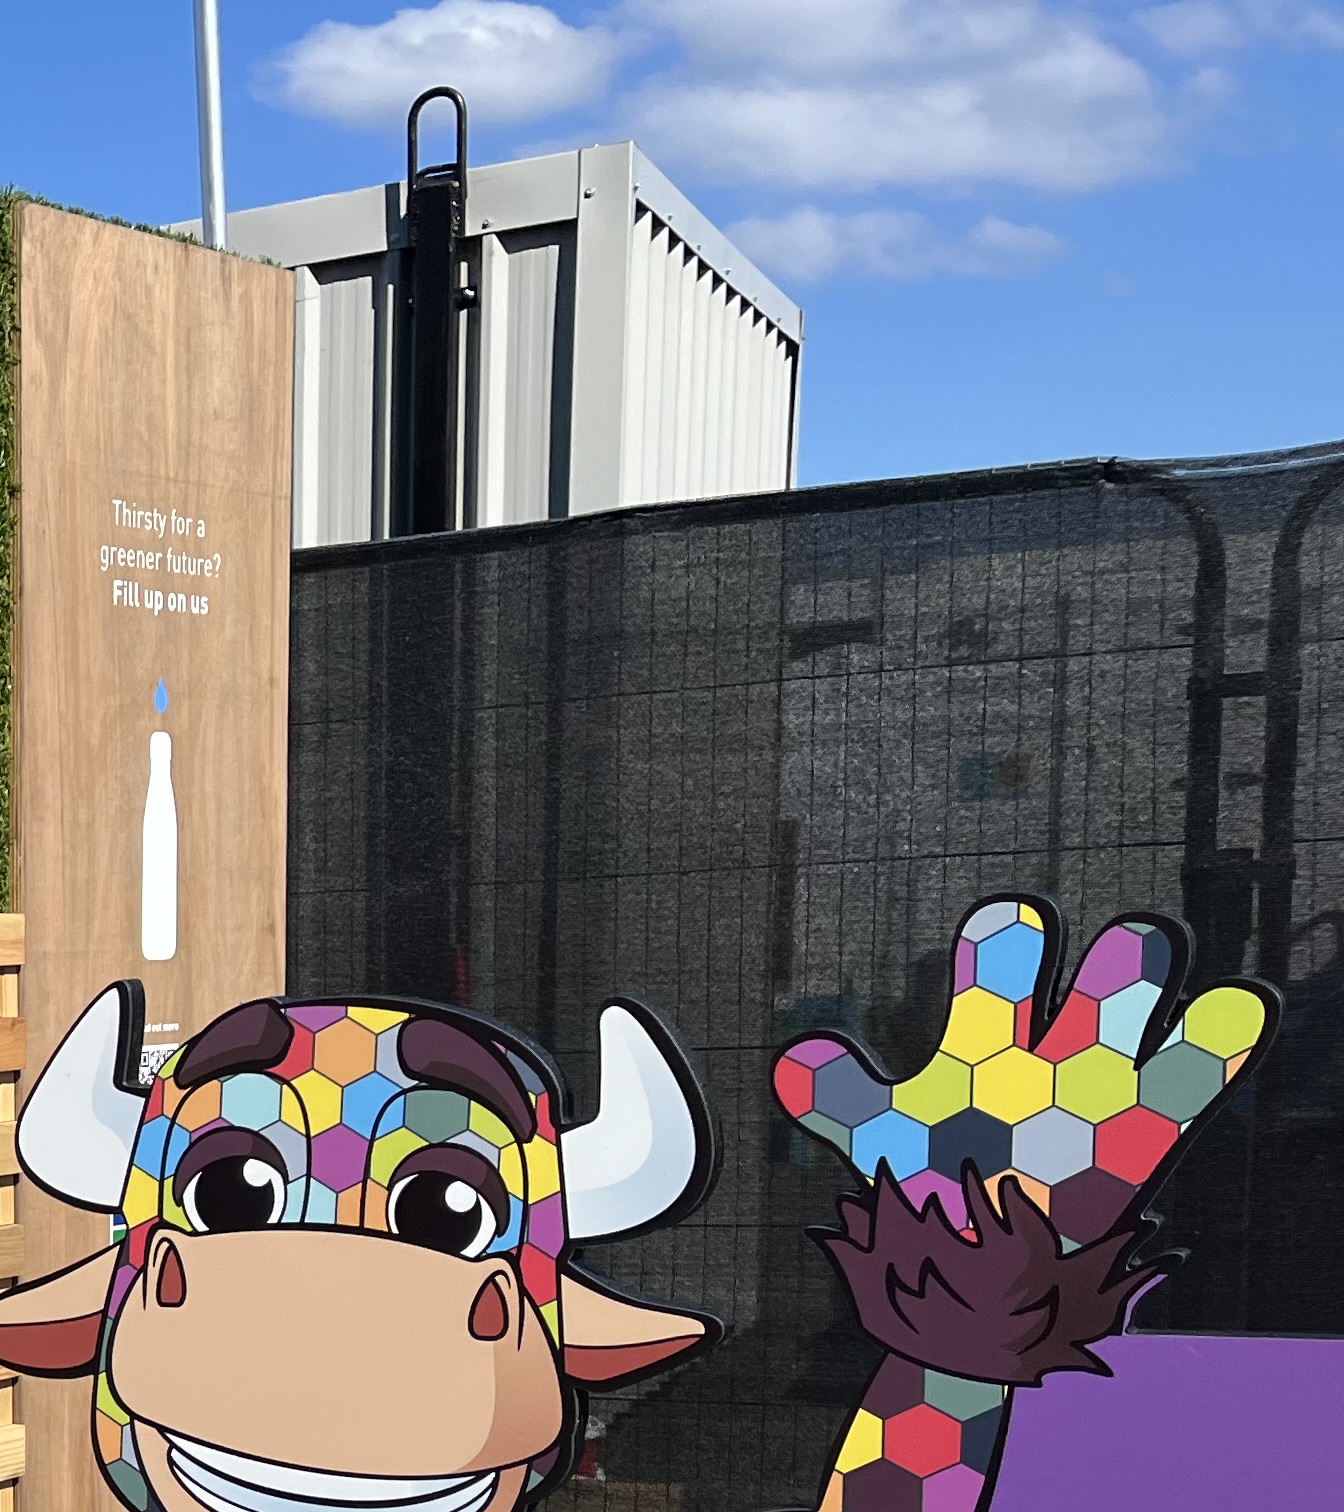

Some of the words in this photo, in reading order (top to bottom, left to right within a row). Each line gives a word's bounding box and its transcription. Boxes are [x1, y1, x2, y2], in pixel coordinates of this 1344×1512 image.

[112, 499, 166, 538] Thirsty
[171, 509, 193, 535] for
[196, 519, 206, 538] a
[100, 545, 163, 571] greener
[167, 547, 221, 578] future?
[113, 579, 140, 607] Fill
[144, 590, 163, 616] up
[167, 592, 186, 612] on
[190, 595, 209, 615] us
